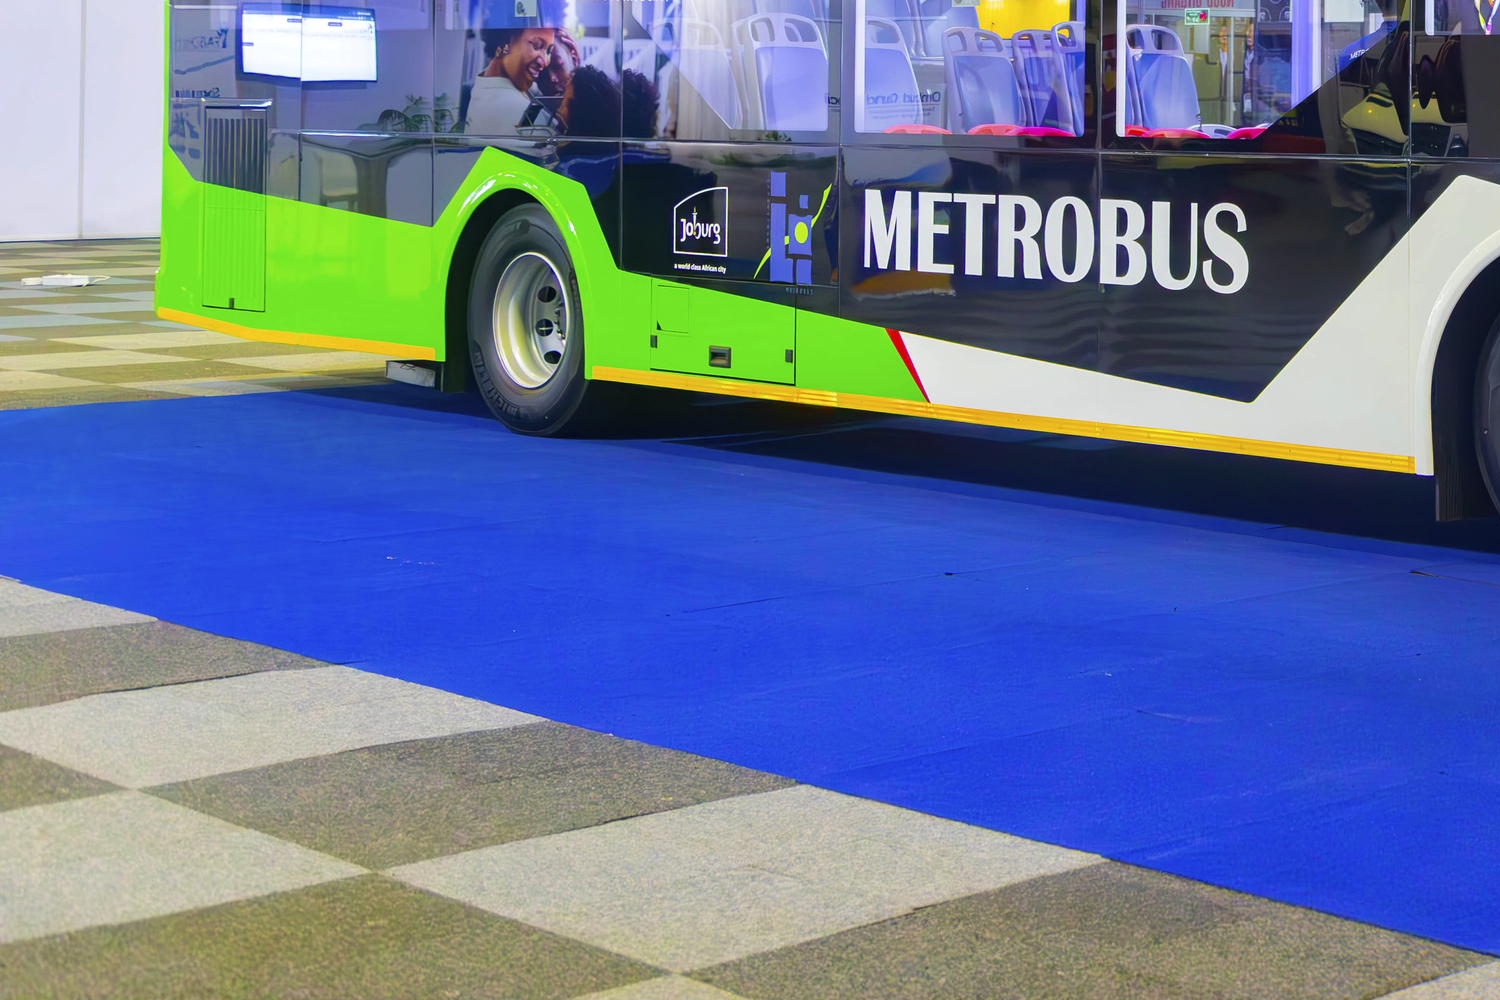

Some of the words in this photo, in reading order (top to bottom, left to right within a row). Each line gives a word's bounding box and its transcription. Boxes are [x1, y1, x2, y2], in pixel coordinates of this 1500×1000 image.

[680, 210, 721, 244] Joburg
[863, 189, 1250, 295] METROBUS
[702, 264, 718, 272] African
[718, 265, 727, 274] city
